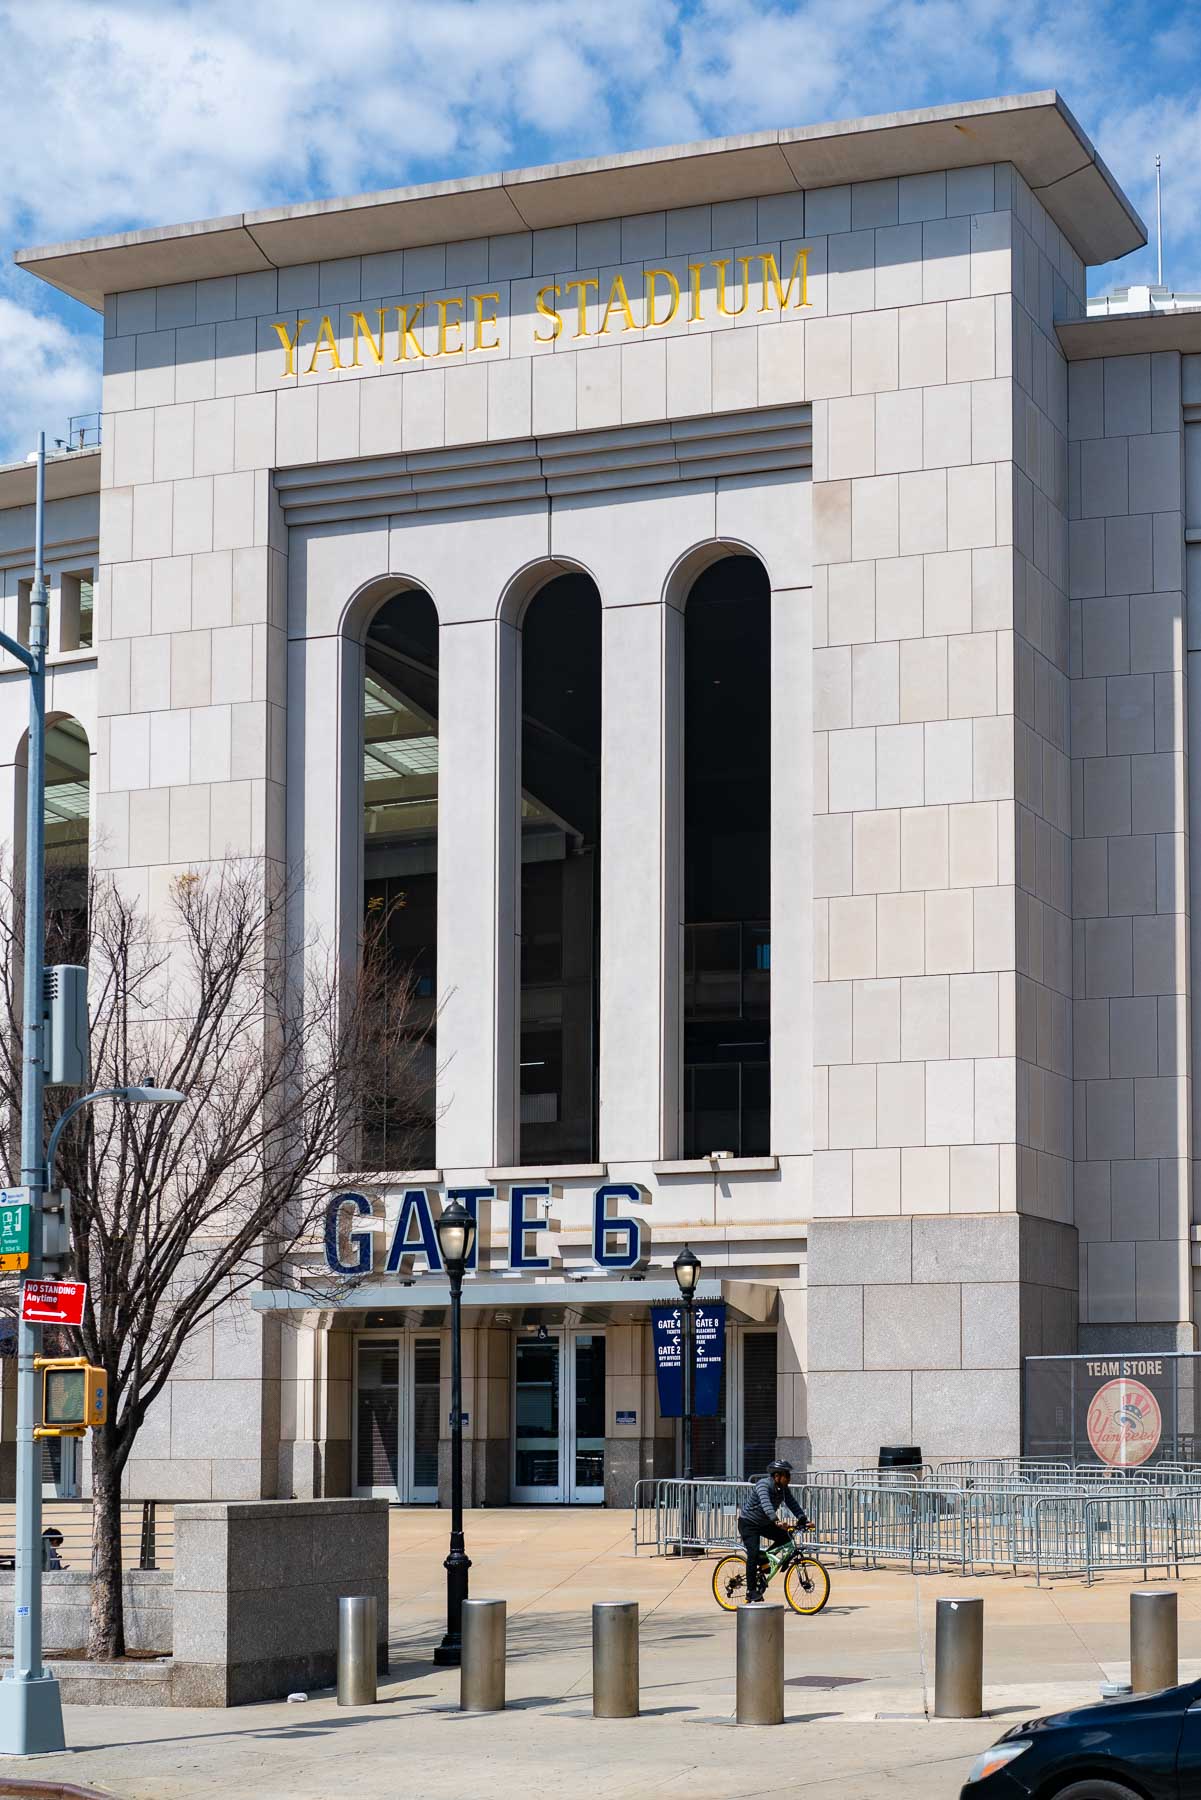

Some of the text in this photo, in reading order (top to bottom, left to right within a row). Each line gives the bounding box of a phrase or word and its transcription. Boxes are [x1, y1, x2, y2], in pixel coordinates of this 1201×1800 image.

[270, 247, 813, 379] YANKEE STADIUM
[323, 1183, 647, 1274] GATE 6
[28, 1284, 76, 1296] NO STANDING
[26, 1293, 58, 1303] Anytime
[658, 1320, 681, 1328] GATE 4
[696, 1318, 719, 1327] GATE 8
[658, 1346, 681, 1355] GATE 2
[1086, 1361, 1162, 1376] TEAM STORE
[1092, 1408, 1154, 1442] Yankees
